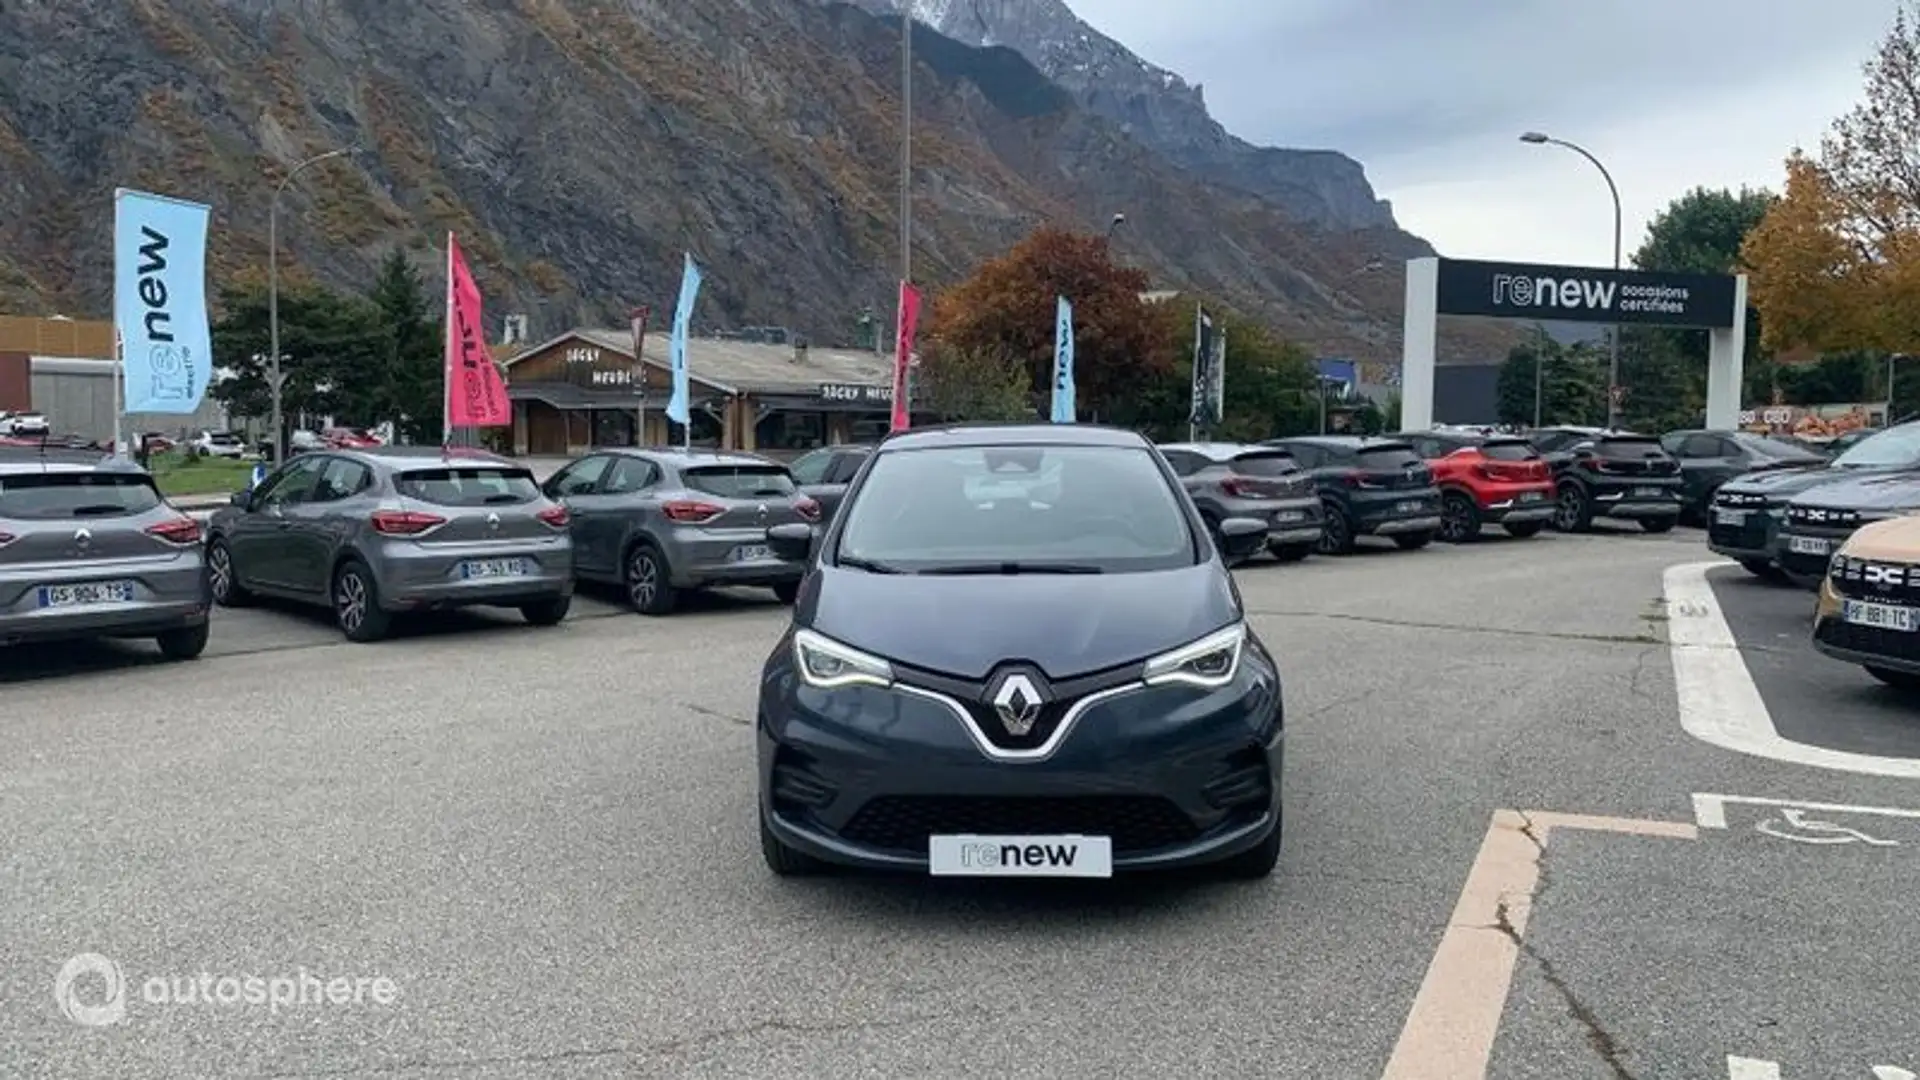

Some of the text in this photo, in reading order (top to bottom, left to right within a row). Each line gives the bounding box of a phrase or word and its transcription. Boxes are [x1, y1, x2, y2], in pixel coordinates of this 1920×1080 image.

[1492, 273, 1617, 310] renew
[1621, 284, 1690, 299] occasions
[138, 225, 184, 400] renew
[961, 843, 1078, 868] renew
